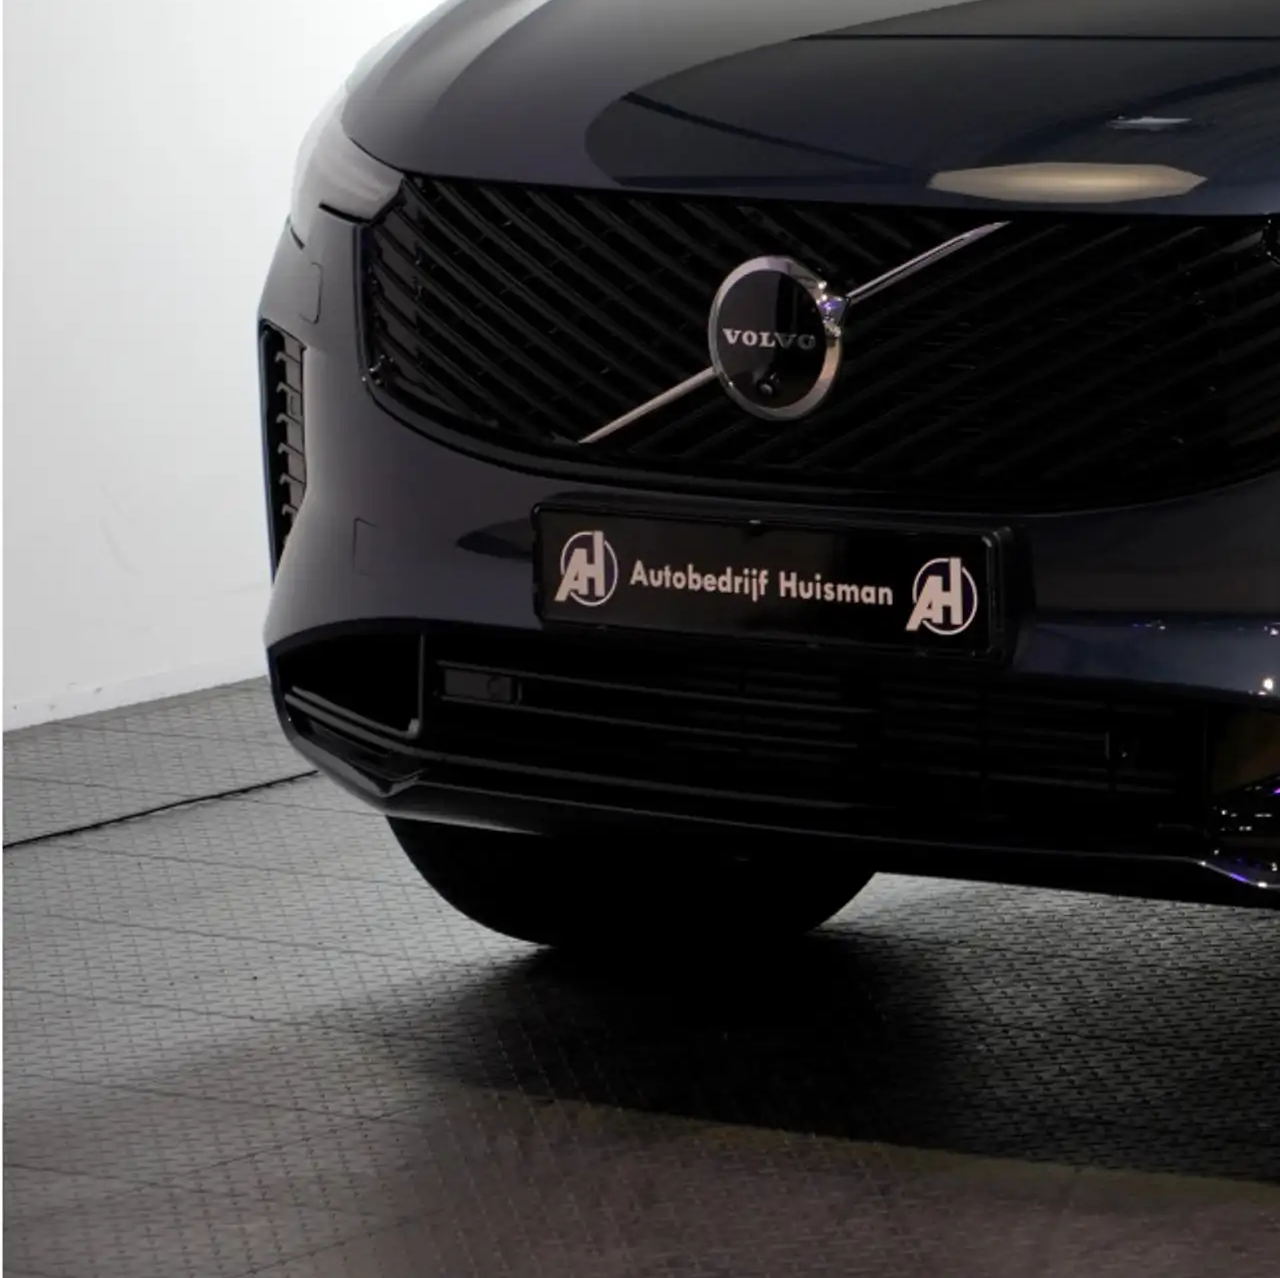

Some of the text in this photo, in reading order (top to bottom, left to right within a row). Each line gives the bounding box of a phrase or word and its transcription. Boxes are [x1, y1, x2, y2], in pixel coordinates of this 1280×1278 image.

[722, 328, 816, 351] VOLVO
[630, 560, 893, 606] Autobedrijf Huisman
